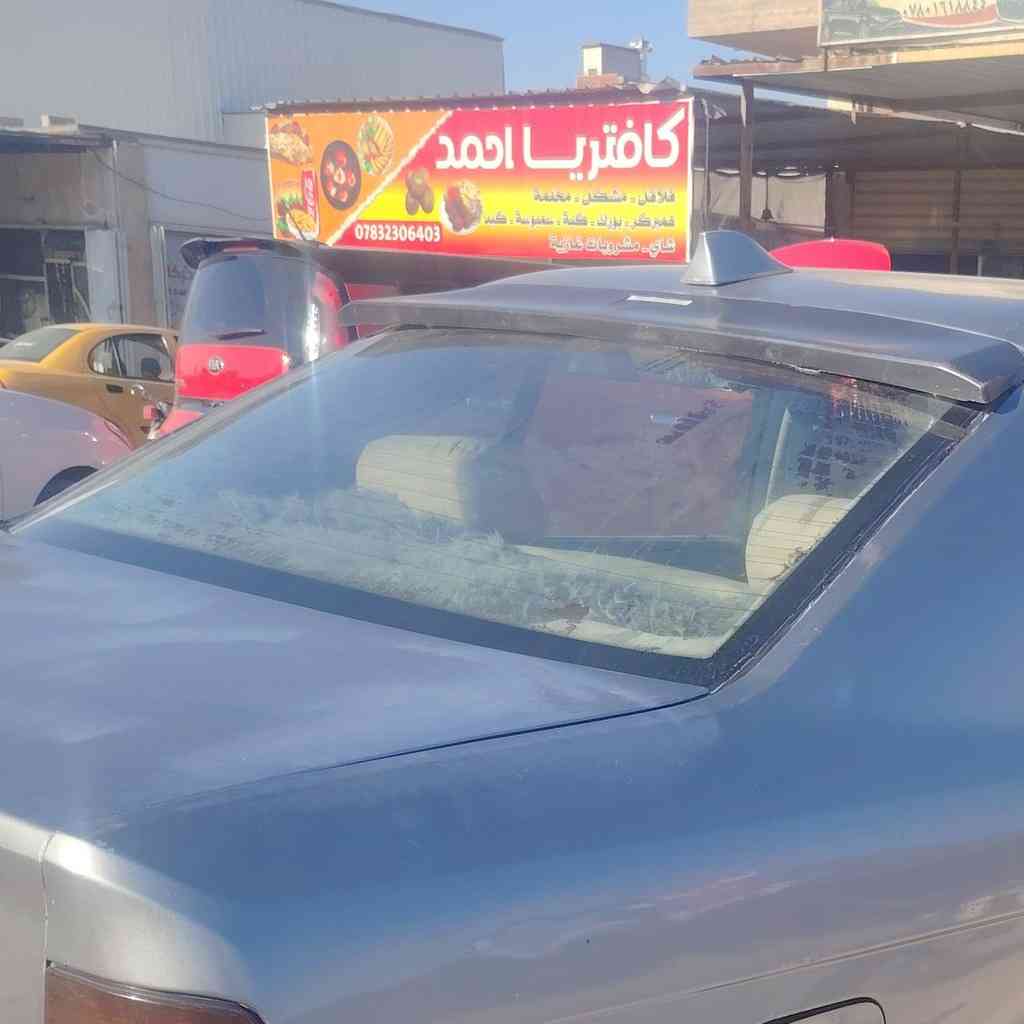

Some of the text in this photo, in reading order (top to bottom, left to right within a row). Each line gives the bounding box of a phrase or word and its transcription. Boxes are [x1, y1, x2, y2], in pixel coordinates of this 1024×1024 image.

[436, 107, 686, 181] كافتريا احمد
[355, 224, 441, 242] 07832306403
